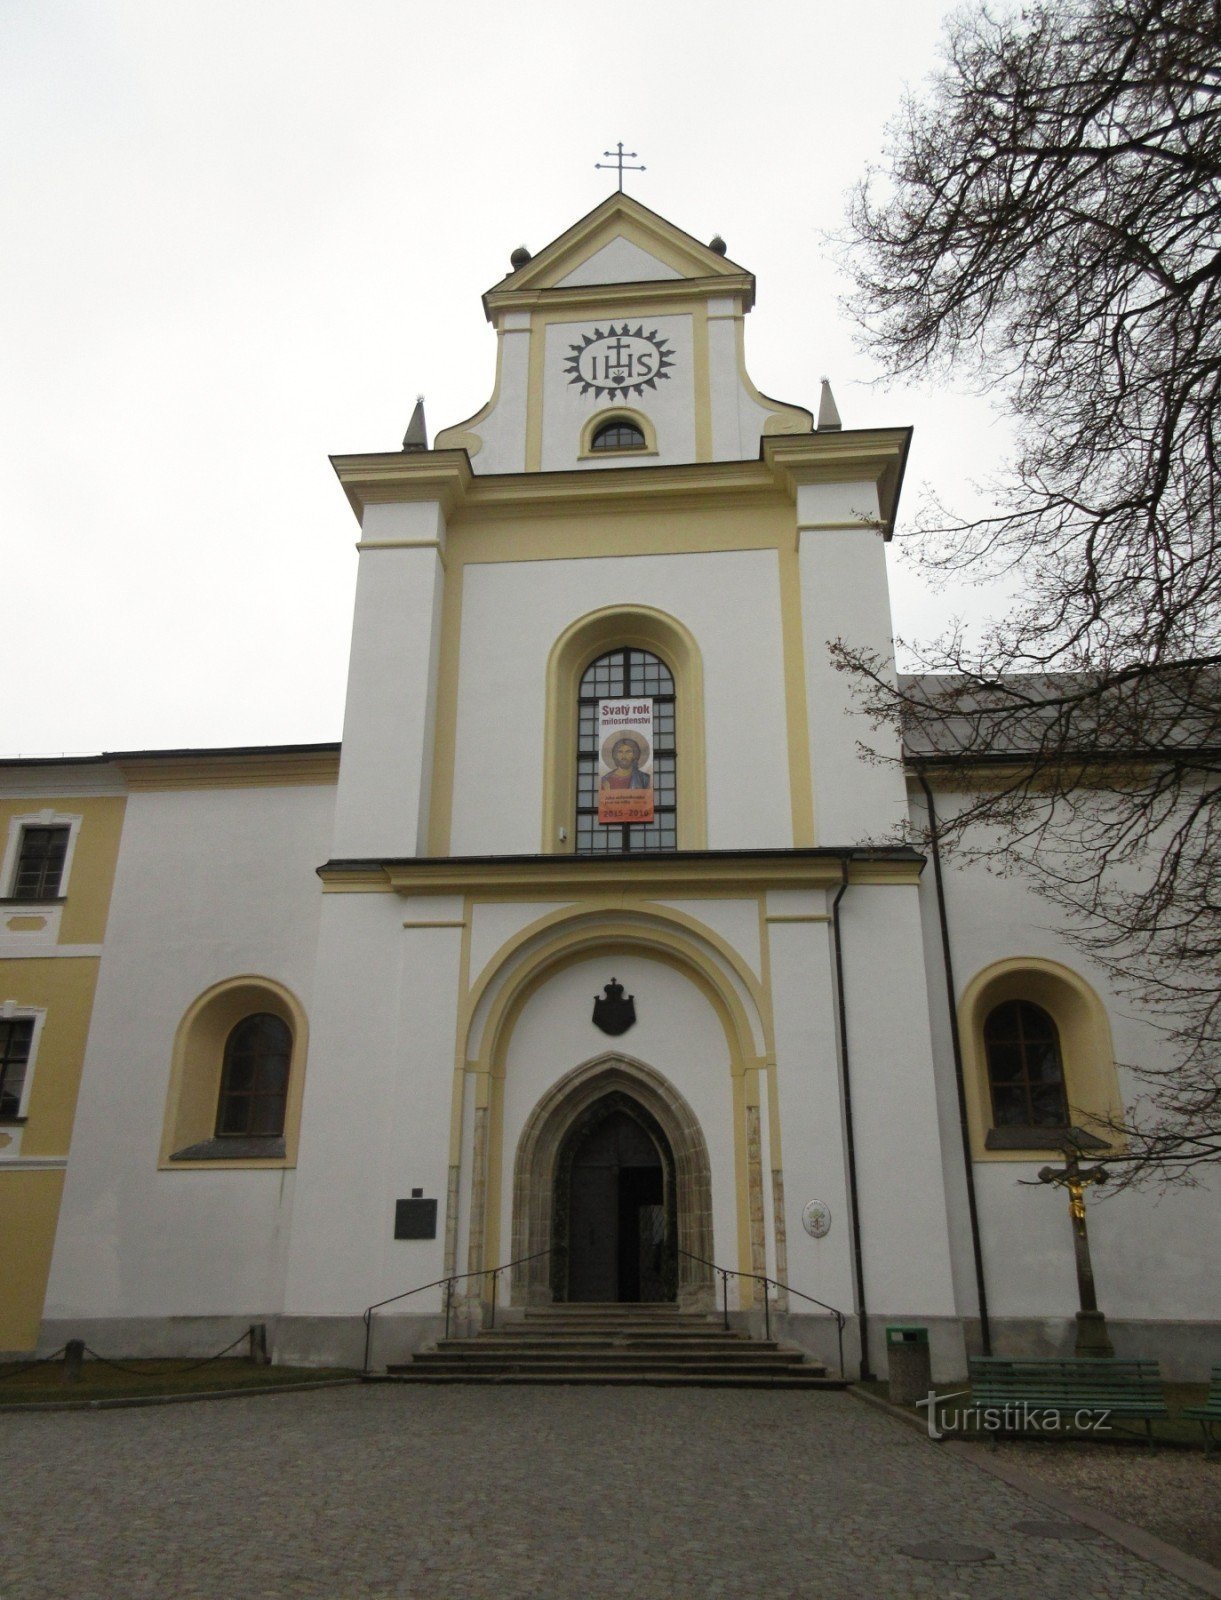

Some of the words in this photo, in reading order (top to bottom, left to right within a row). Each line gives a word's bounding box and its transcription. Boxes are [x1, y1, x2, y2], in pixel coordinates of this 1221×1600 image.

[592, 352, 653, 380] IHS
[602, 704, 630, 716] Svatý
[633, 704, 649, 715] rok
